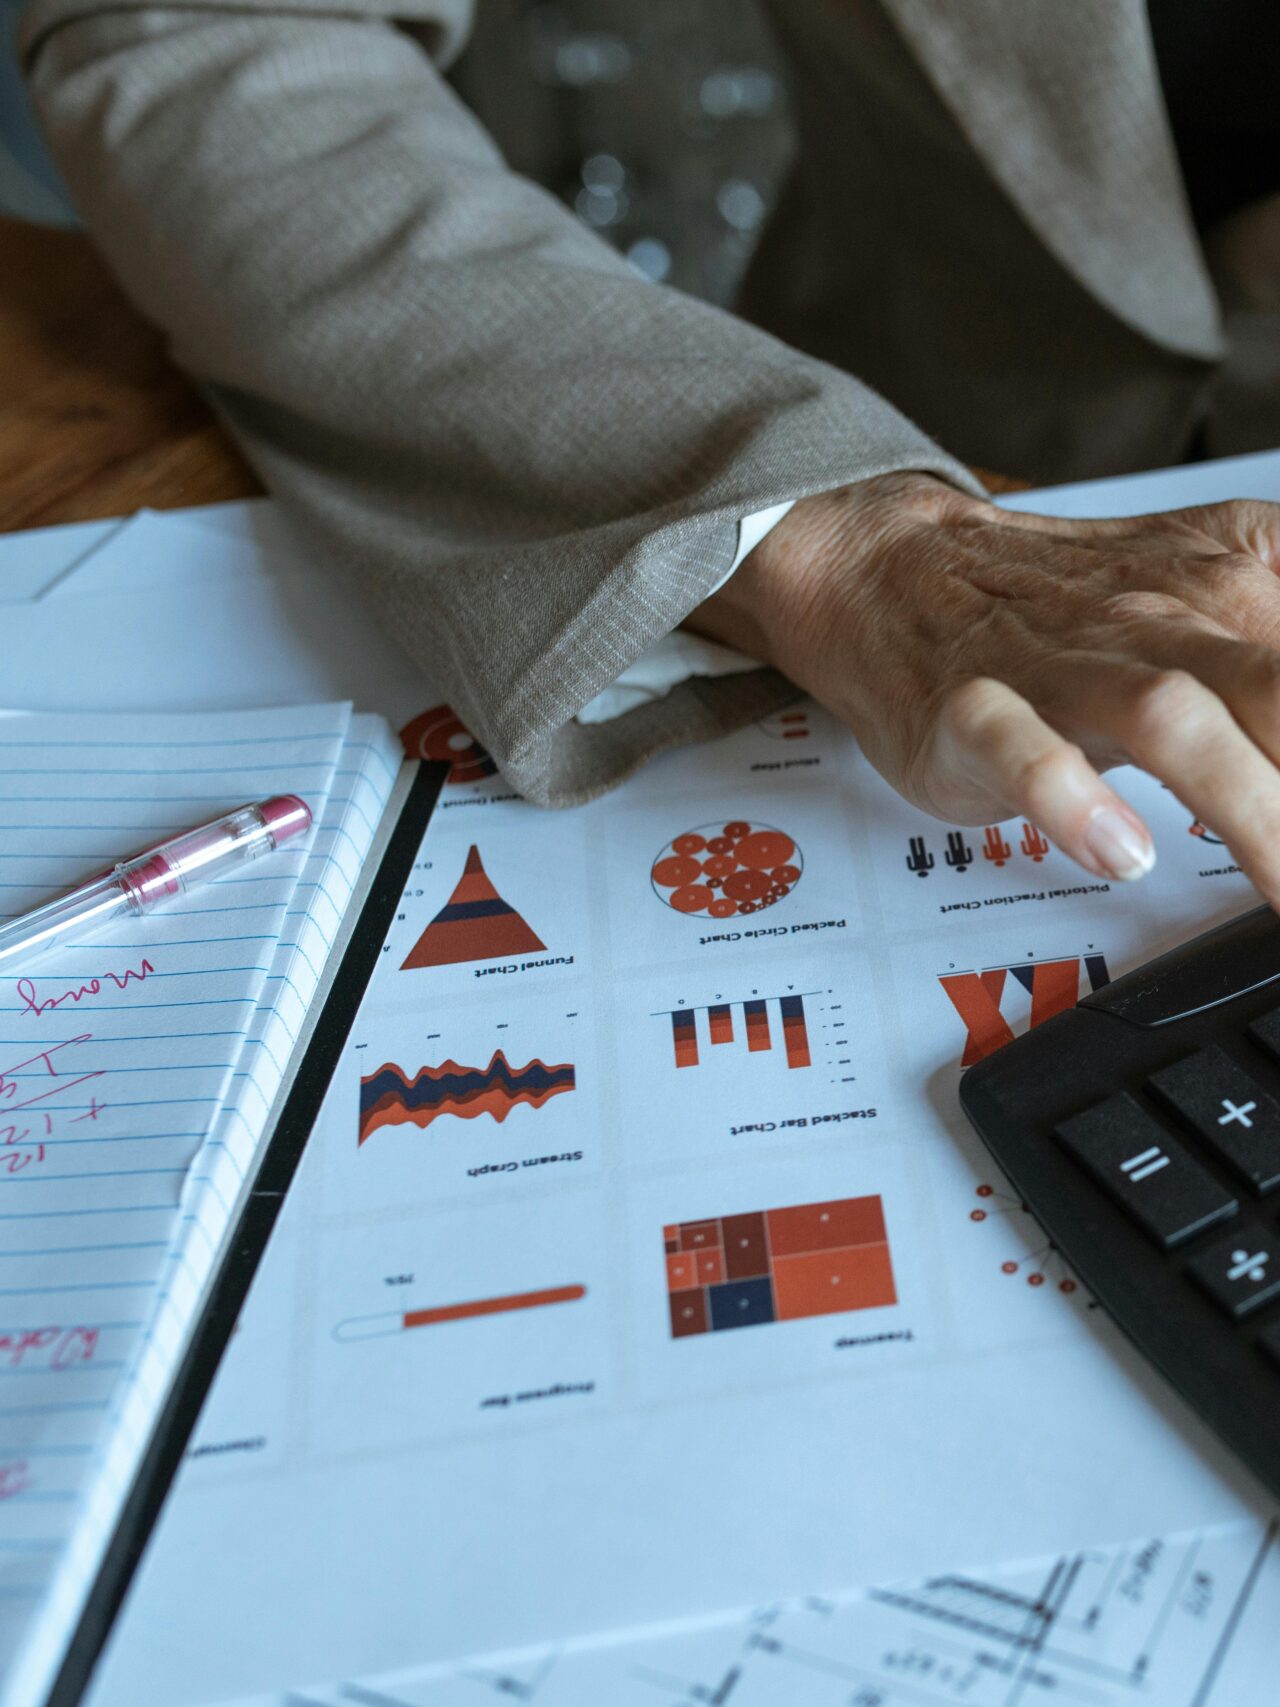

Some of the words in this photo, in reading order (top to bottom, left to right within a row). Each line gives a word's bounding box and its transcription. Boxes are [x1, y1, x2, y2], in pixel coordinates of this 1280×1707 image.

[984, 891, 1045, 907] Fraction
[1048, 884, 1110, 899] Pictorial
[940, 901, 981, 914] Chart
[745, 926, 788, 938] Circle
[791, 919, 846, 933] Packed
[699, 933, 741, 945] Chart
[474, 965, 518, 978] Chart
[521, 956, 574, 972] Funnel
[780, 1118, 807, 1128] Bar
[812, 1108, 877, 1126] Stacked
[730, 1122, 776, 1136] Chart
[523, 1151, 583, 1169] Stream
[467, 1162, 518, 1178] Graph
[835, 1329, 914, 1351] Treemap
[515, 1381, 595, 1404] Progress
